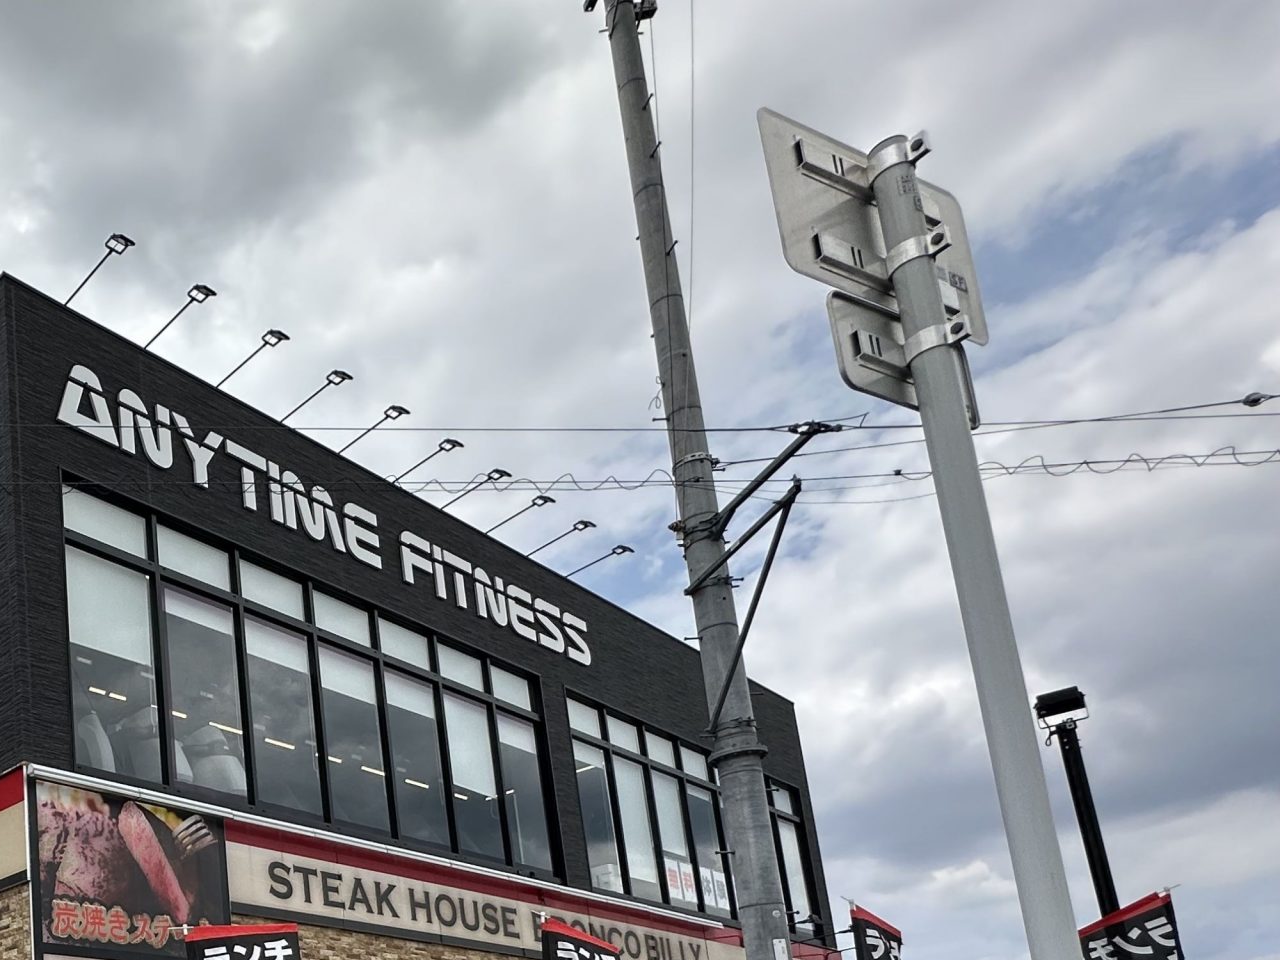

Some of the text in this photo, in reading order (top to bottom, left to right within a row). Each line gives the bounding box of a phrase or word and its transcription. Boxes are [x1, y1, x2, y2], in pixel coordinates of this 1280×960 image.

[55, 364, 592, 667] ANYTIME FITNESS
[52, 899, 209, 949] 炭焼きステ
[267, 861, 400, 919] STEAK
[407, 887, 520, 939] HOUSE
